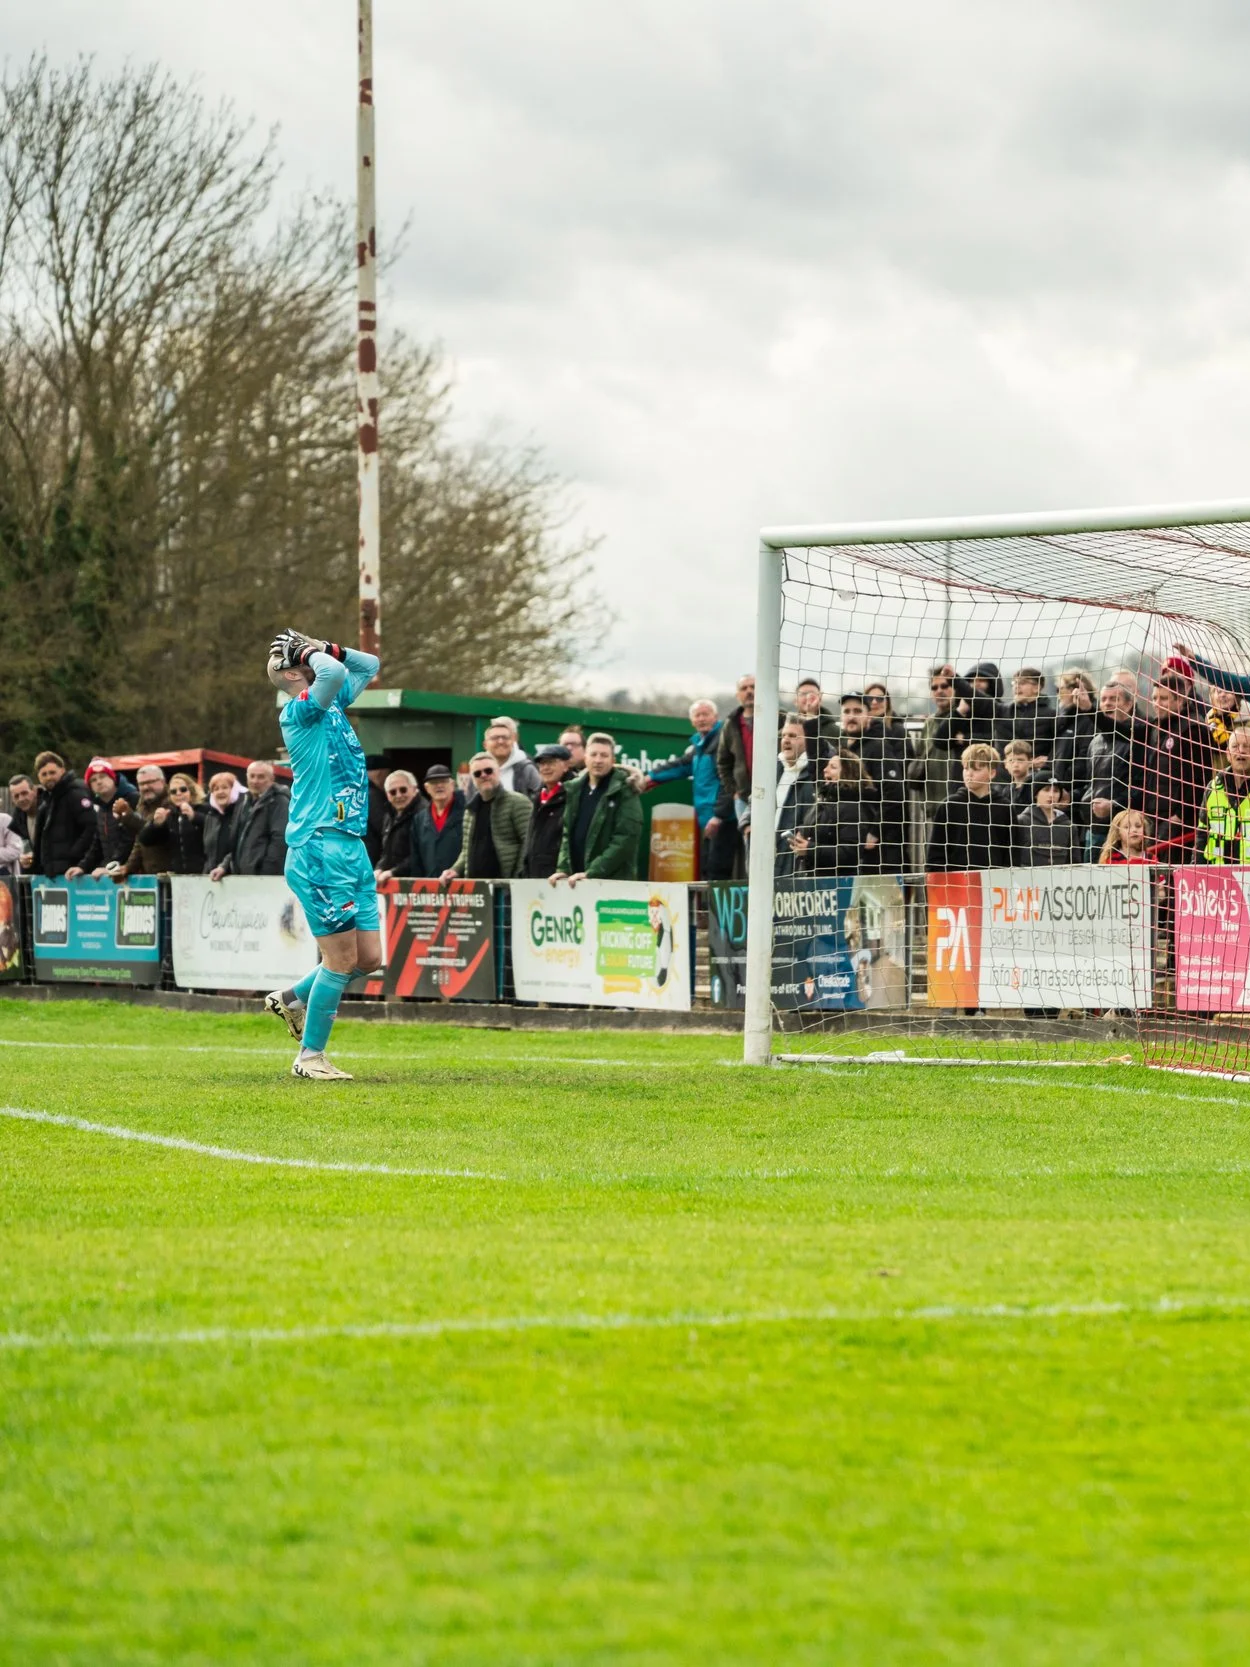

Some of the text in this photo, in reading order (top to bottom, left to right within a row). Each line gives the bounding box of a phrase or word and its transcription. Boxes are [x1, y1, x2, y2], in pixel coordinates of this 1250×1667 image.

[713, 886, 749, 943] WB
[772, 890, 838, 917] ORKFORCE
[992, 884, 1140, 922] PLANASSOCIATES
[1178, 878, 1239, 924] Bailey's
[774, 924, 807, 937] ATHROOMS
[936, 908, 972, 972] PA
